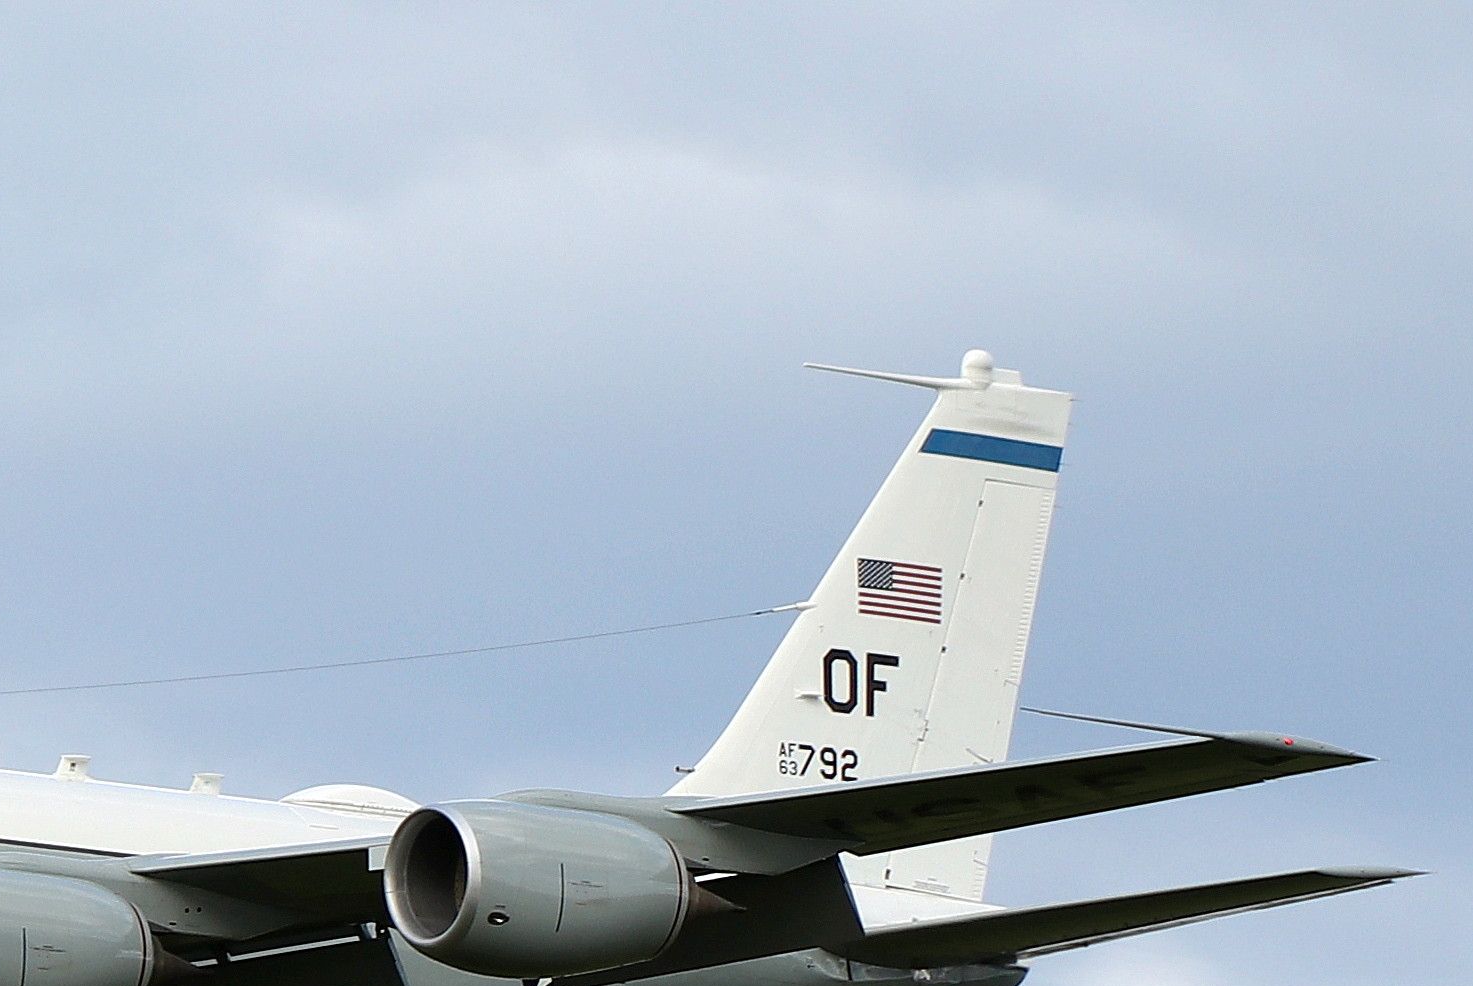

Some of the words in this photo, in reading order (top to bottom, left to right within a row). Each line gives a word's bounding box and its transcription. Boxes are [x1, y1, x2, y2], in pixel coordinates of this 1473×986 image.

[823, 648, 900, 717] OF
[779, 742, 797, 757] AF
[798, 744, 858, 781] 792
[779, 760, 798, 775] 63
